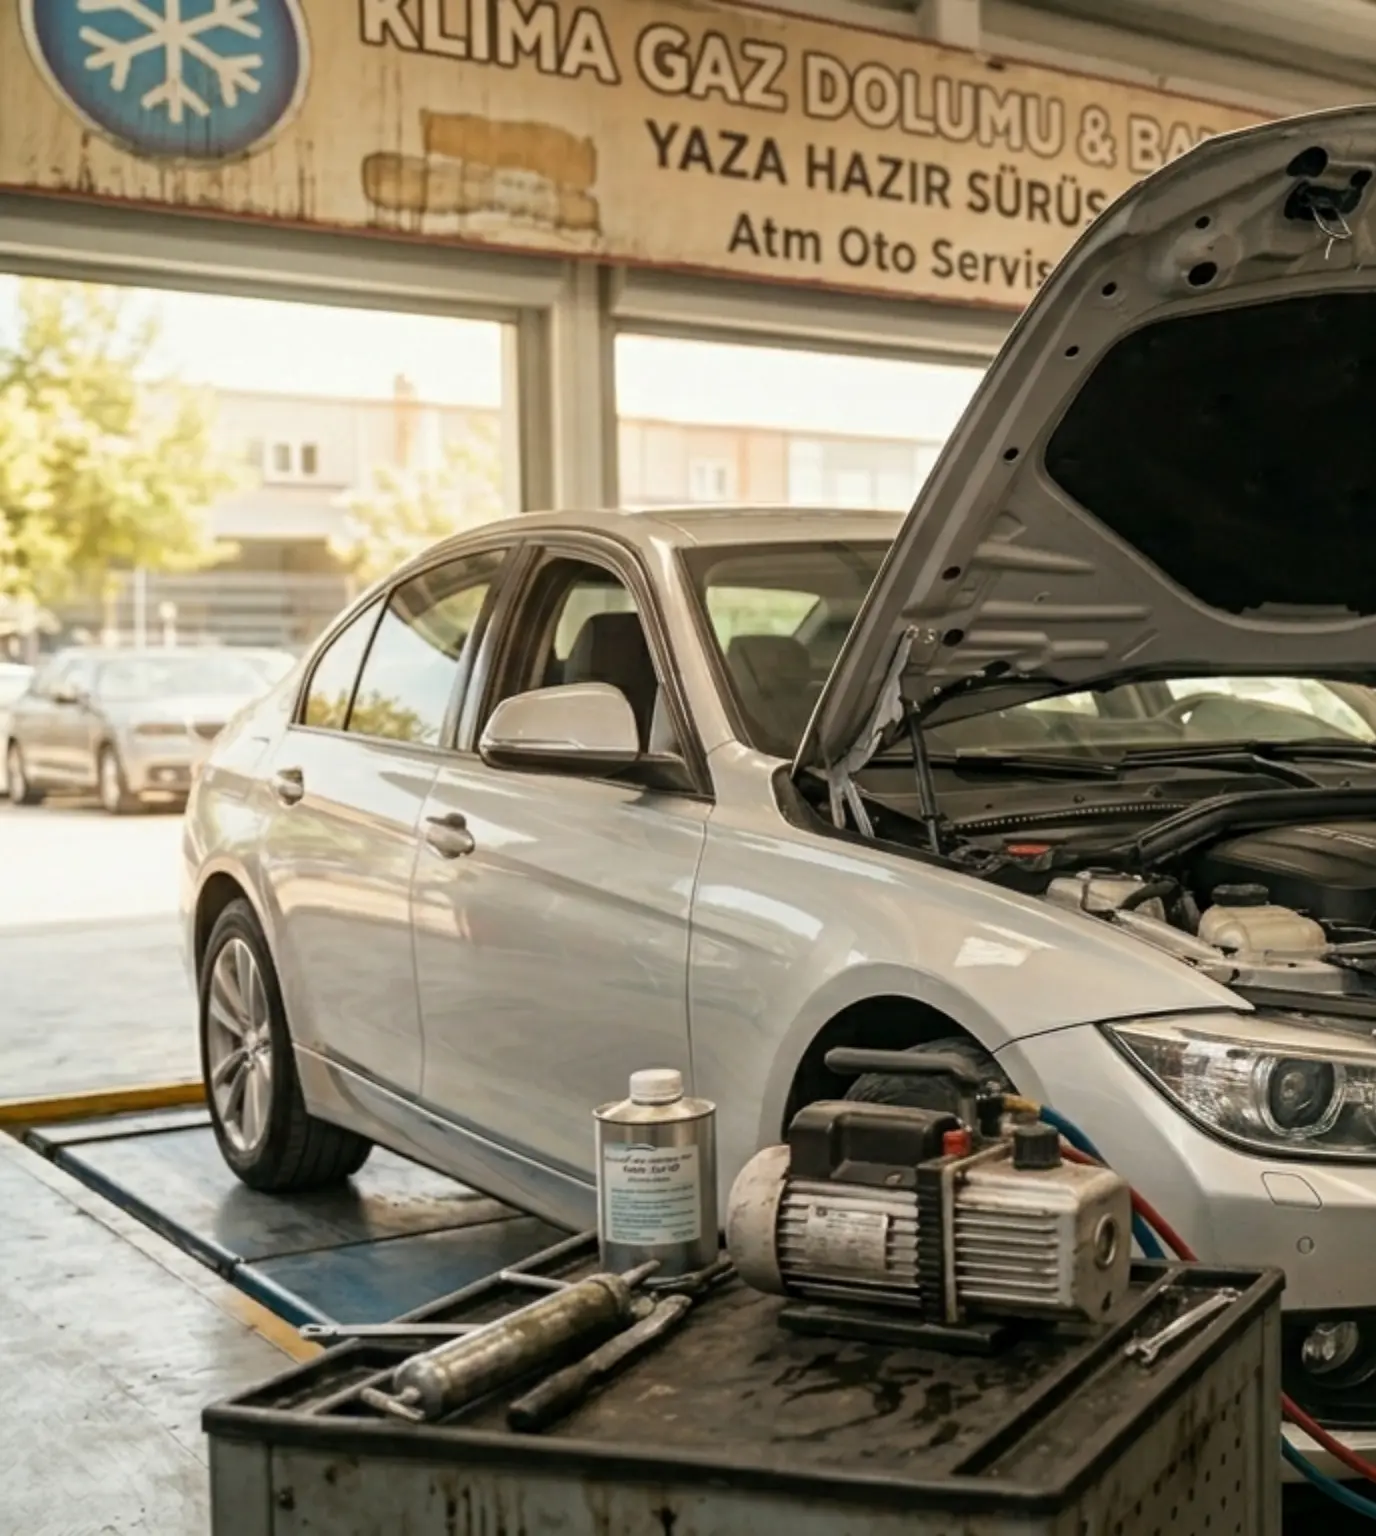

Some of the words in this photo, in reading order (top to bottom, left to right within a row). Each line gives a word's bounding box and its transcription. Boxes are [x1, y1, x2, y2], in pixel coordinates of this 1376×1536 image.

[635, 22, 789, 112] GAZ
[802, 50, 1066, 157] DOLUMU
[1076, 104, 1117, 168] &
[1127, 113, 1217, 174] BA
[646, 119, 788, 187] YAZA
[806, 143, 951, 209] HAZIR
[728, 212, 821, 264] Atm
[839, 226, 917, 273] Oto
